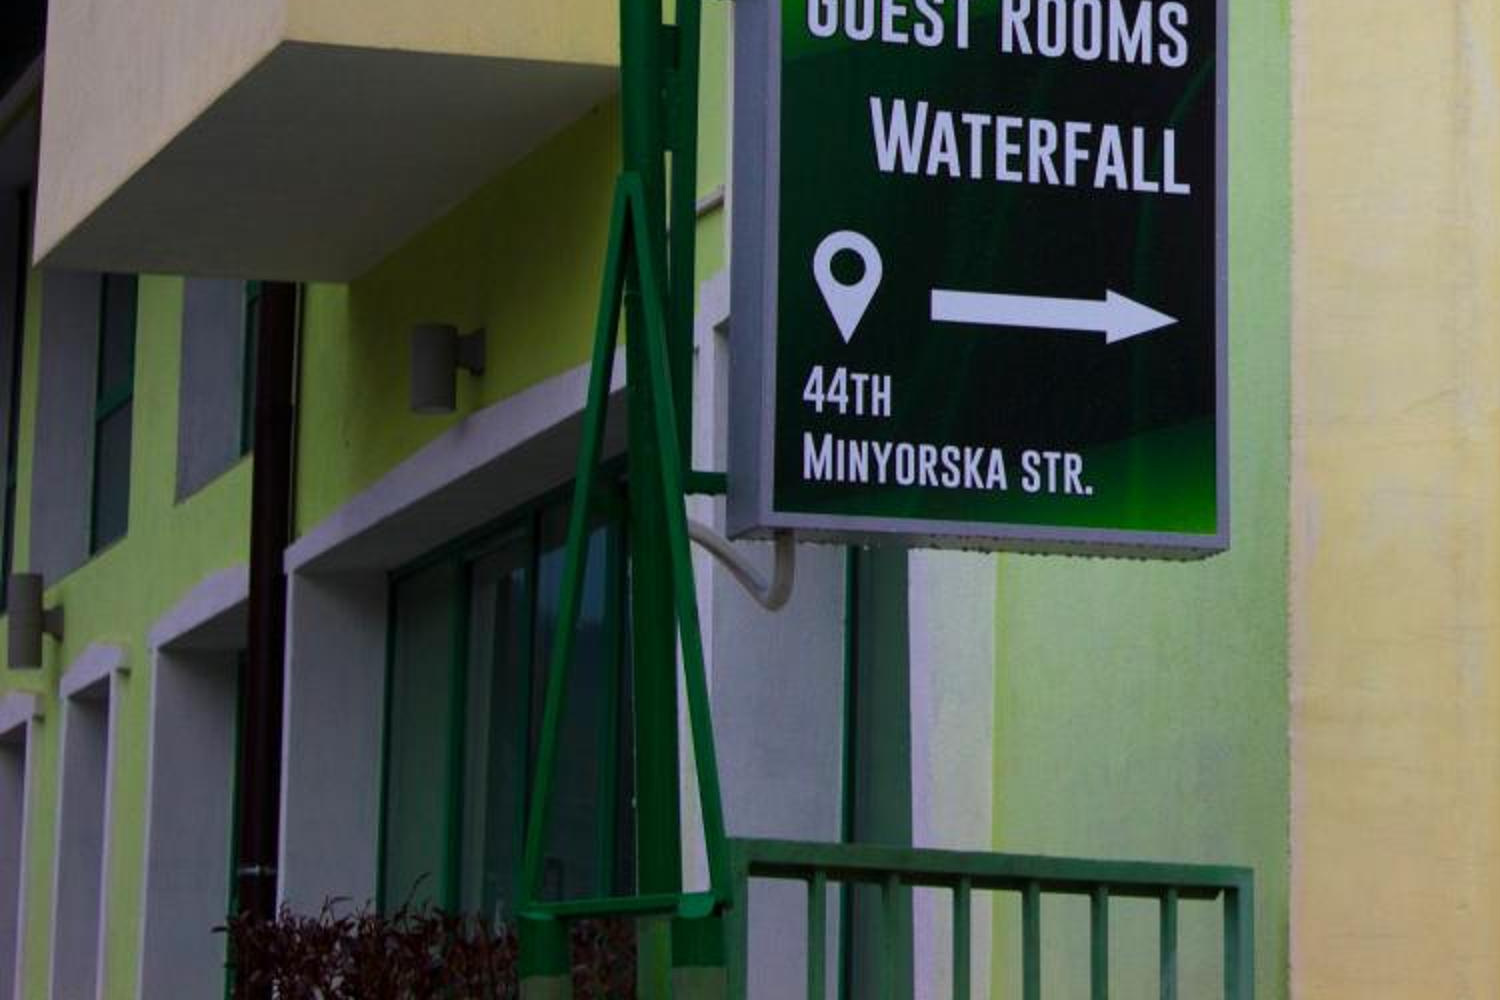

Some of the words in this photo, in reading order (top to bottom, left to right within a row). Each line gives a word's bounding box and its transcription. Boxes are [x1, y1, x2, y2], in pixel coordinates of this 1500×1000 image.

[869, 96, 1191, 195] WATERFALL
[803, 365, 891, 417] 44TH
[803, 432, 1008, 491] MINYORSKA
[1021, 449, 1093, 495] STR.
